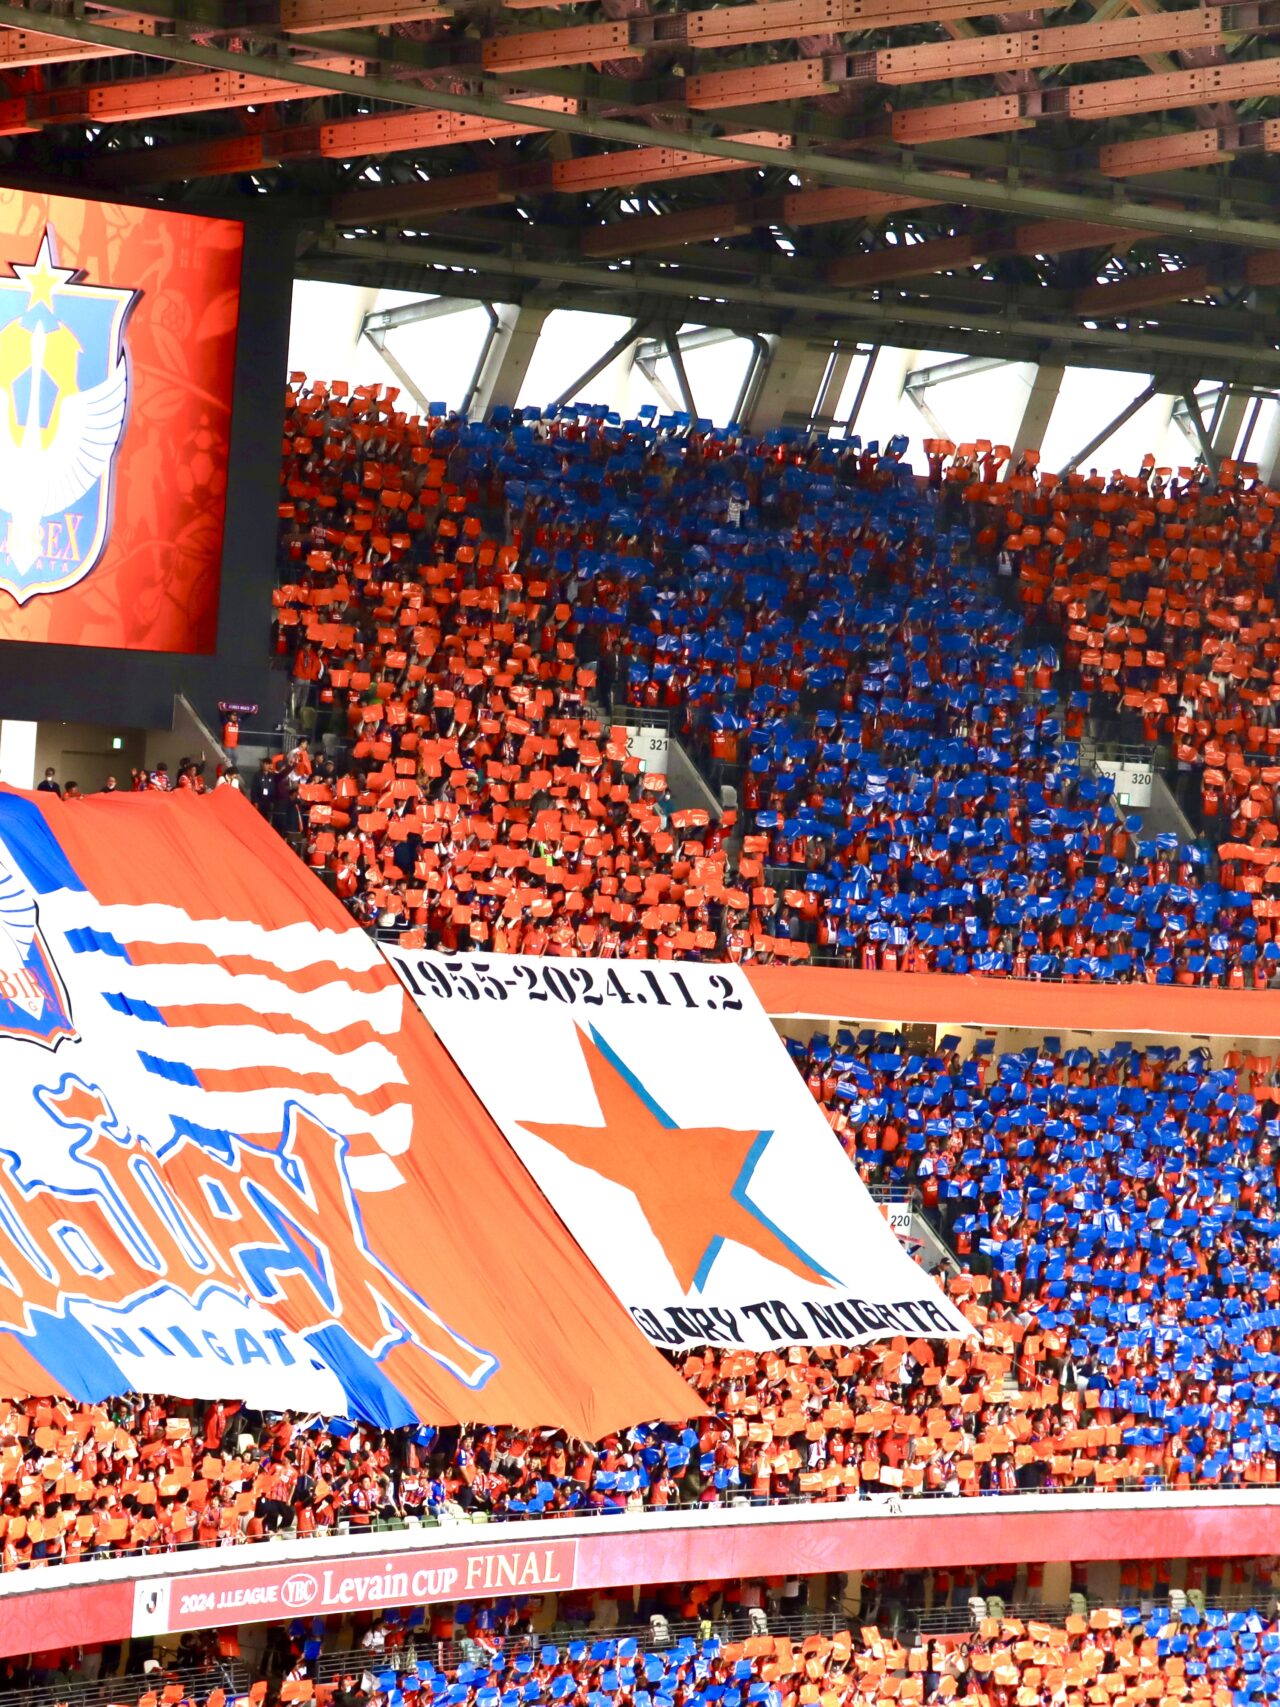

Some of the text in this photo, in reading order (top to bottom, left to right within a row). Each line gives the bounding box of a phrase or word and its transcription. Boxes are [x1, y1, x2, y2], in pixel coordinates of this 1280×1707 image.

[649, 738, 669, 751] 321
[1131, 773, 1152, 785] 320
[392, 956, 743, 1011] 1955-2024.11.2
[890, 1214, 911, 1227] 220
[629, 1306, 745, 1345] GLORY
[739, 1299, 808, 1341] TO
[91, 1324, 326, 1371] NIIGAT
[179, 1549, 562, 1614] 2024 J.LEAGUE YBC Levain CUP FINAL
